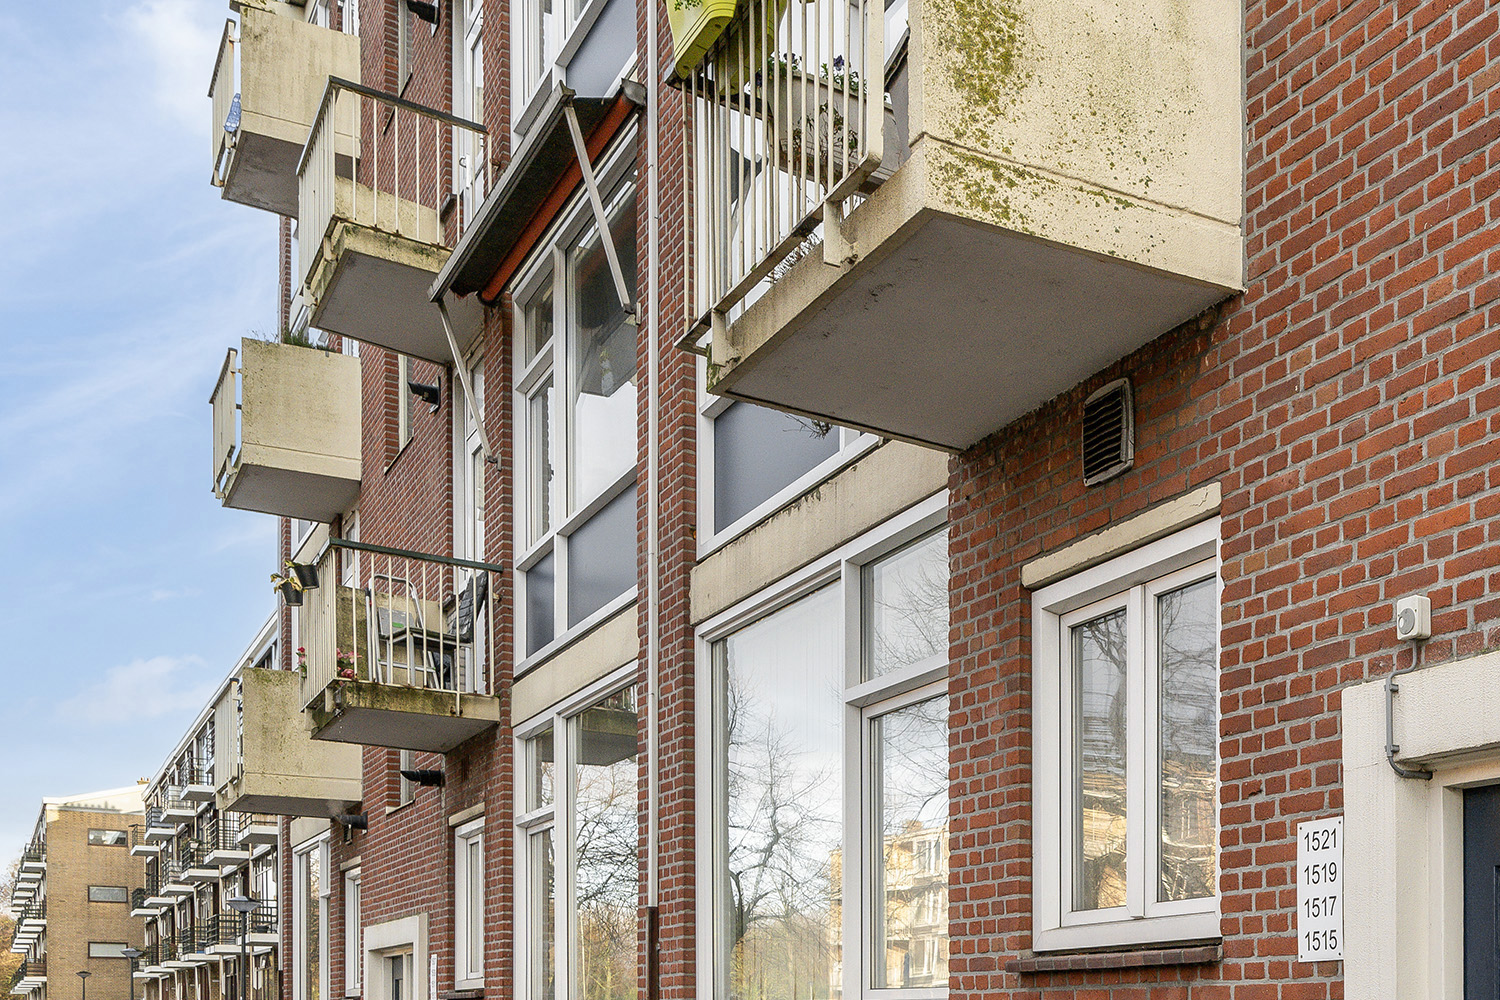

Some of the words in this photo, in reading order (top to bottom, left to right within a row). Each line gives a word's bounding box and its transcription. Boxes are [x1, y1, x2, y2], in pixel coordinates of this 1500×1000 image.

[1304, 828, 1337, 851] 1521
[1304, 862, 1337, 885] 1519
[1304, 896, 1337, 918] 1517
[1304, 929, 1338, 951] 1515
